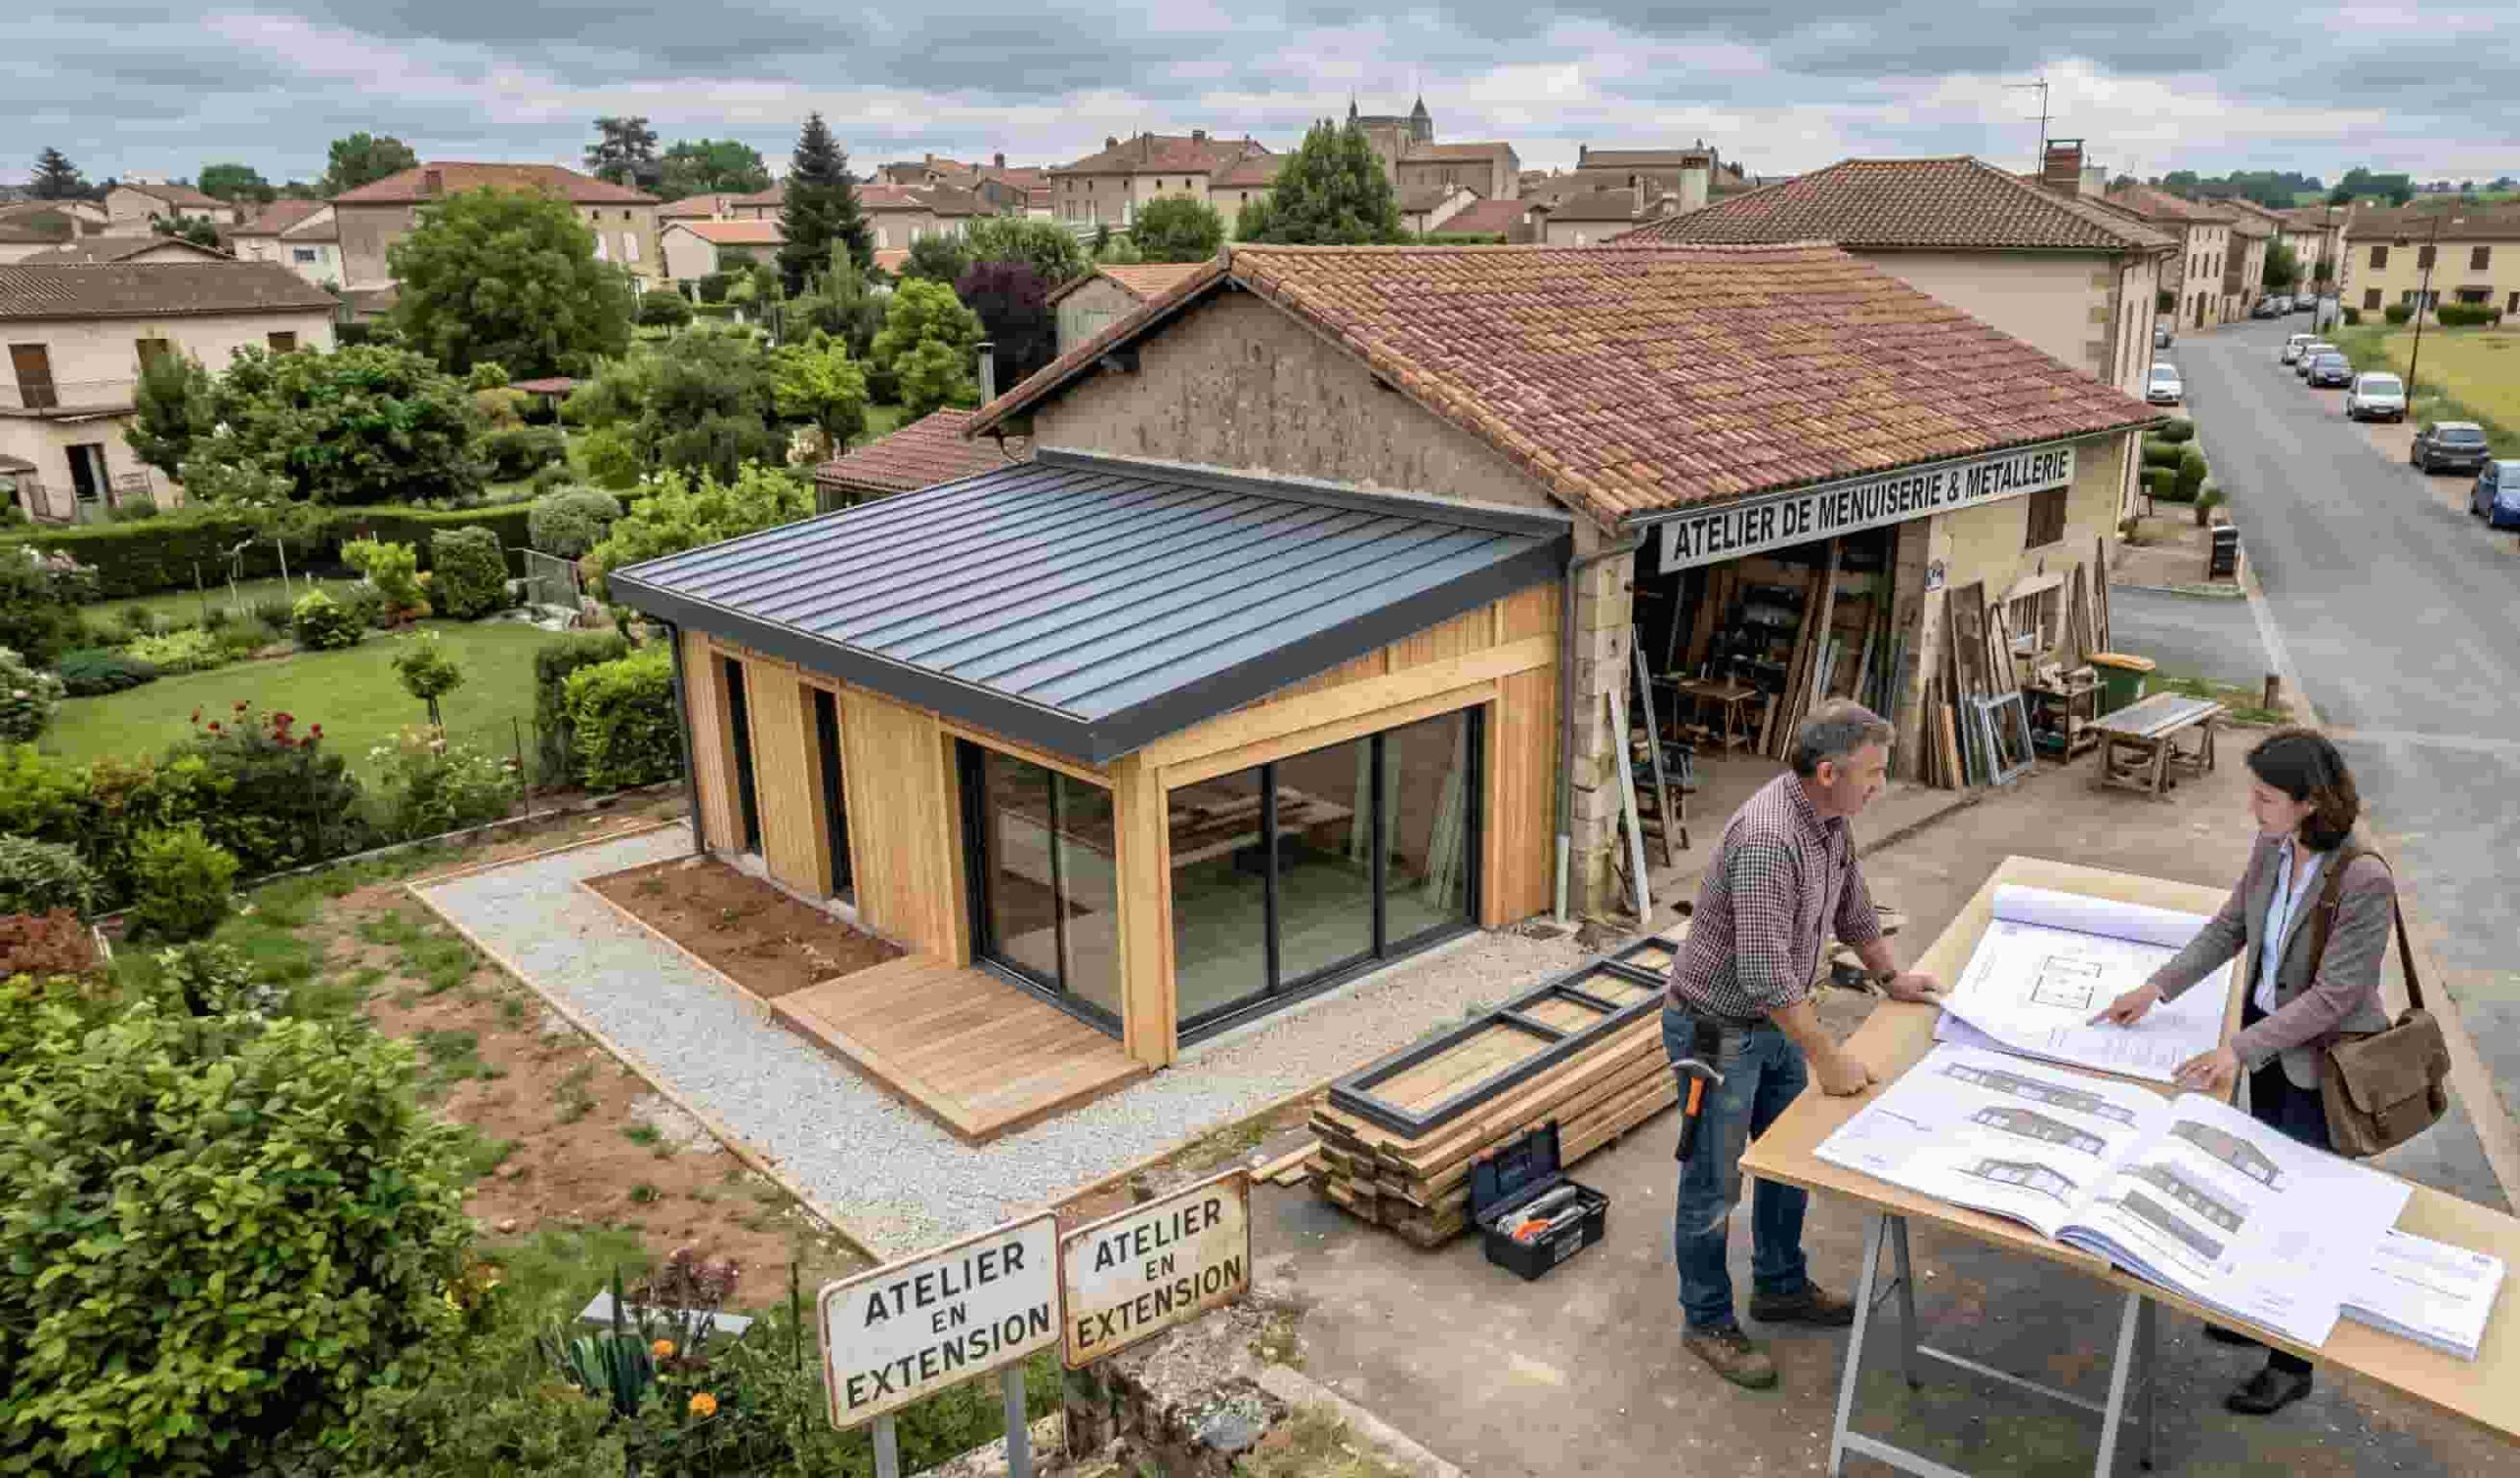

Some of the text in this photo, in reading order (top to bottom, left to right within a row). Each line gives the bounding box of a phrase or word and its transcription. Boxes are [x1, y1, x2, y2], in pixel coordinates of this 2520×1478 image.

[1673, 450, 2069, 560] ATELIER DE MENUISERIE & METALLERIE
[1095, 1197, 1222, 1272] ATELIER
[1146, 1253, 1175, 1282] EN
[864, 1241, 1025, 1327] ATELIER
[931, 1302, 967, 1334] EN
[1077, 1255, 1240, 1349] EXTENSION
[846, 1302, 1050, 1409] EXTENSION
